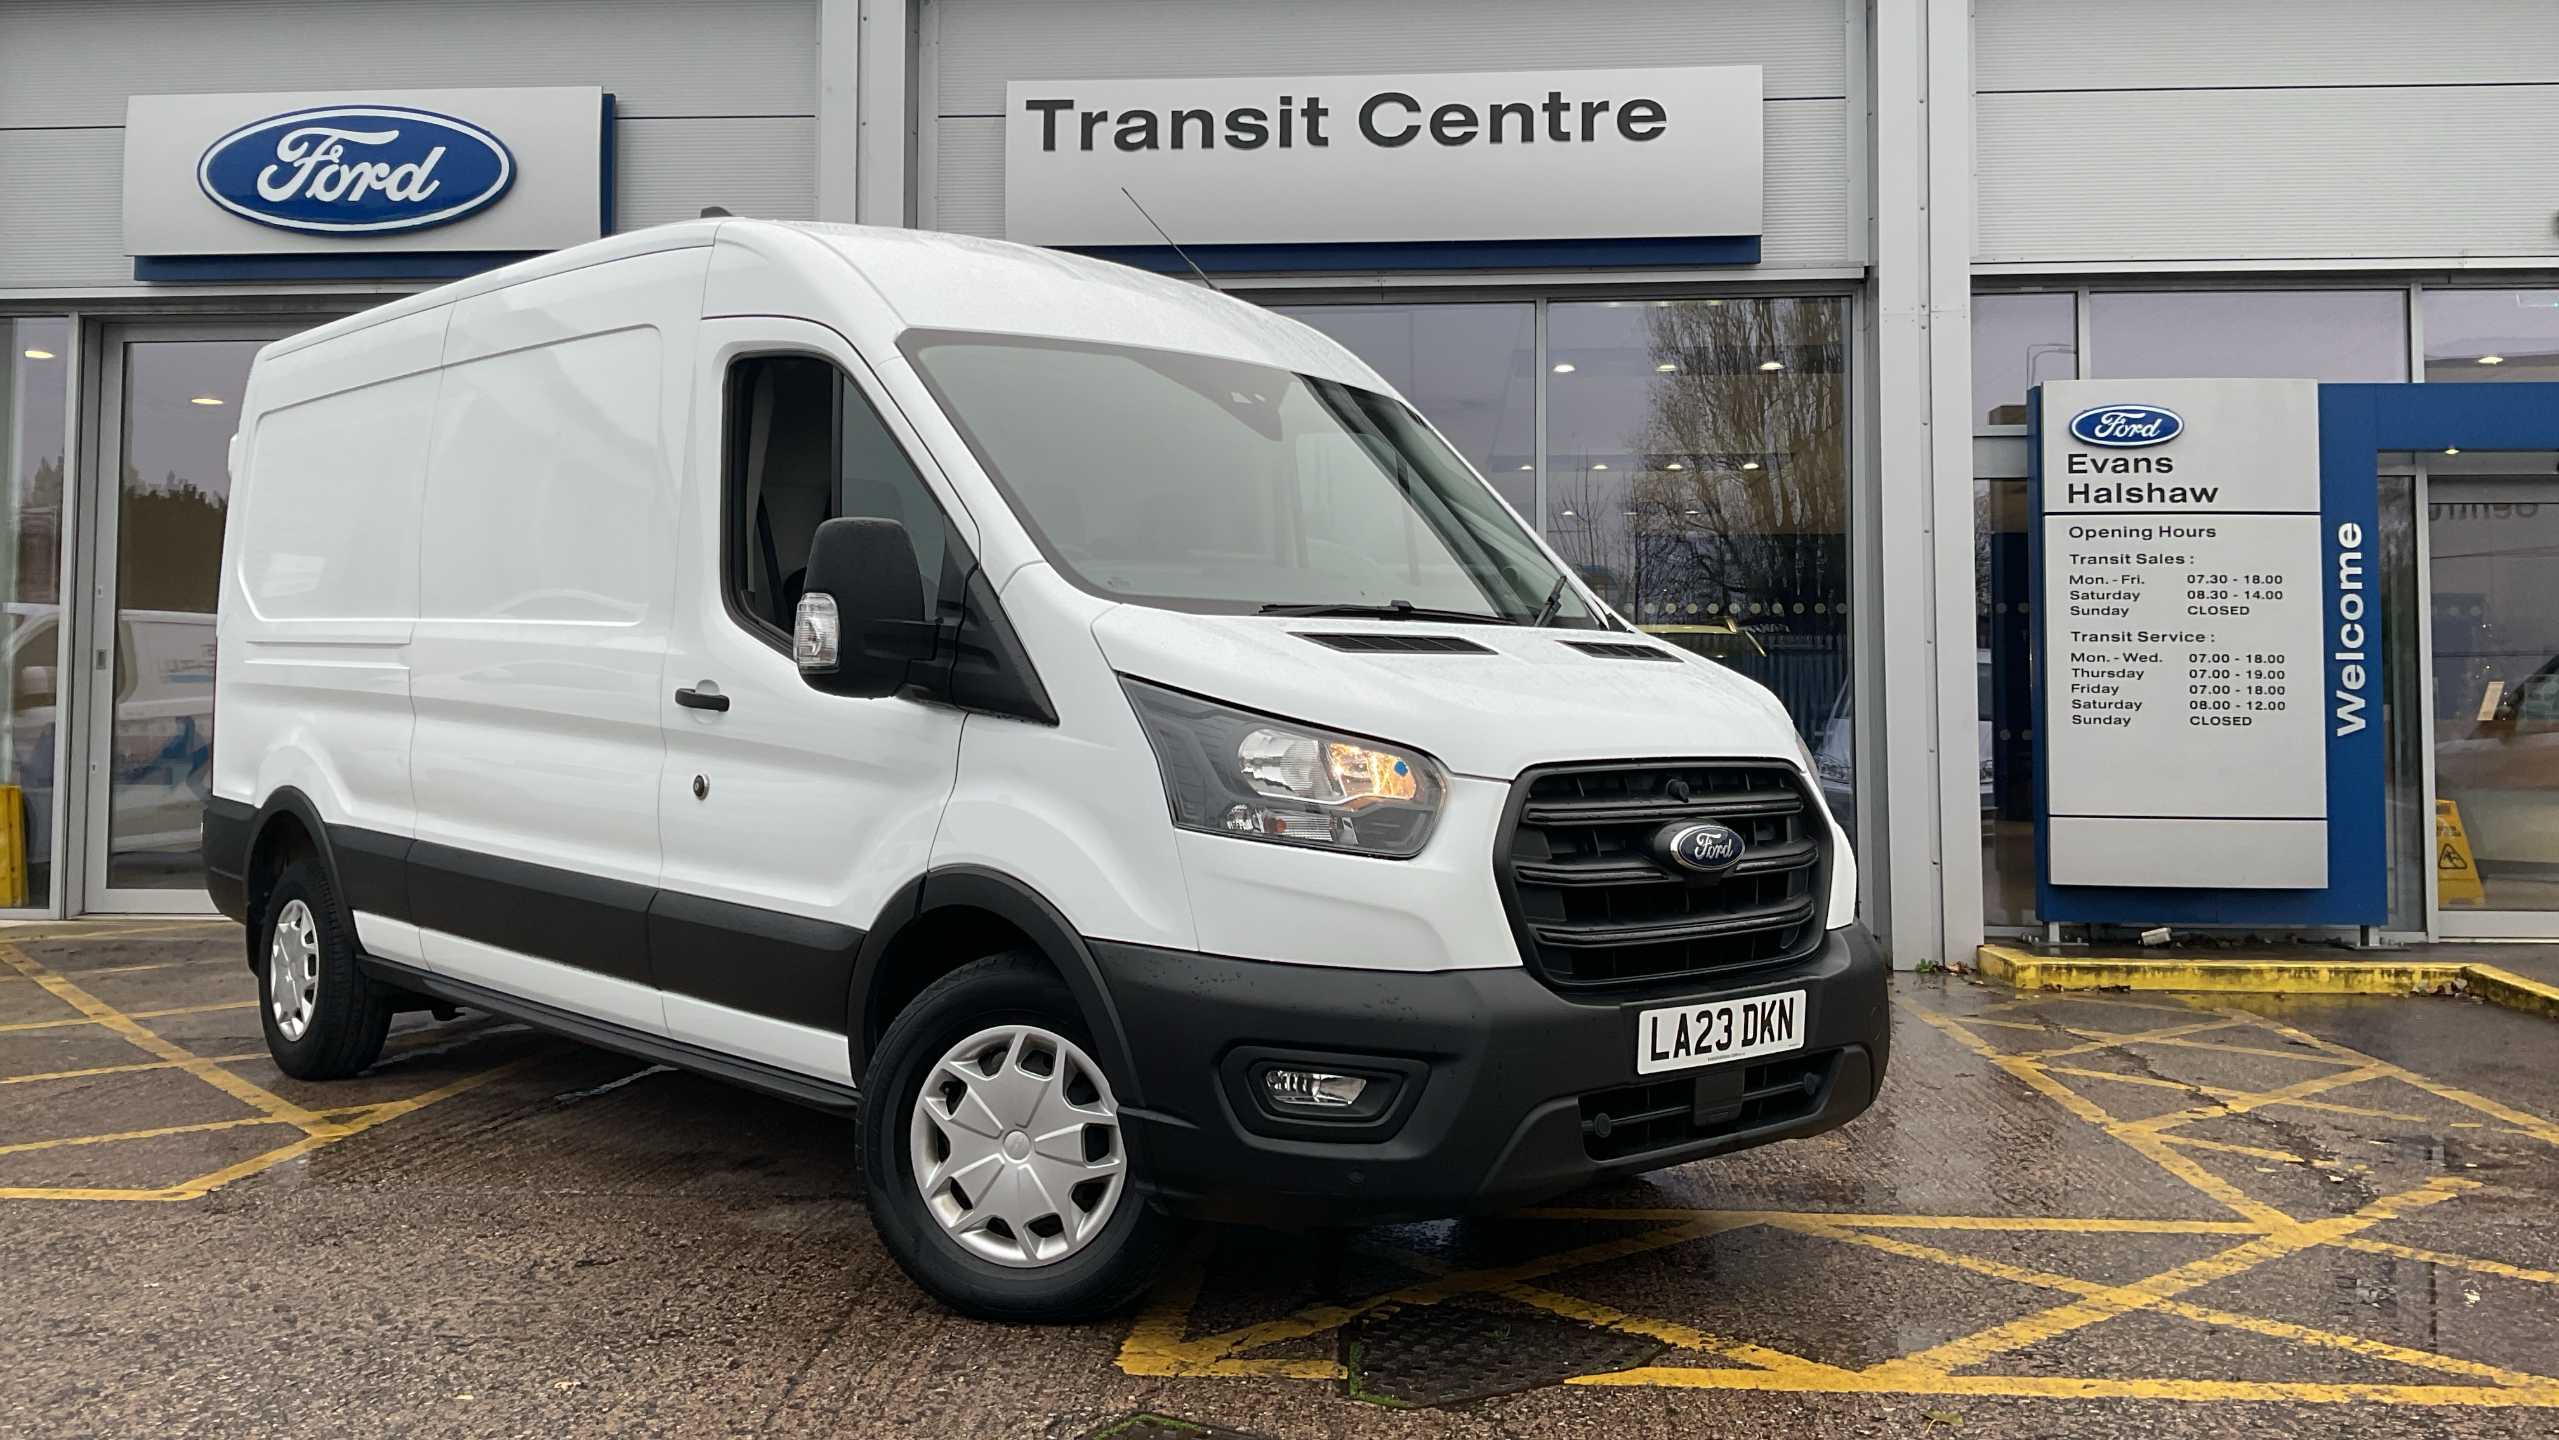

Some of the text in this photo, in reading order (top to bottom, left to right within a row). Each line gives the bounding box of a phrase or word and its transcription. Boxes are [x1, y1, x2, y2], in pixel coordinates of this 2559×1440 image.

[1026, 92, 1666, 152] Transit Centre
[257, 127, 446, 202] Ford
[2095, 411, 2161, 438] Ford
[2068, 453, 2173, 474] Evans
[2069, 483, 2218, 503] Halshaw
[2068, 525, 2217, 542] Opening Hours
[2068, 553, 2132, 565] Transit
[2135, 553, 2186, 565] Sales
[2069, 574, 2109, 585] Mon.
[2121, 574, 2145, 585] Fri.
[2186, 574, 2228, 585] 07.30
[2243, 574, 2283, 585] 18.00
[2069, 590, 2141, 603] Saturday
[2186, 590, 2229, 600] 08.30
[2244, 590, 2284, 601] 14.00
[2070, 605, 2250, 618] Sunday CLOSED
[2070, 631, 2133, 643] Transit
[2137, 630, 2206, 643] Service
[2336, 523, 2365, 736] Welcome
[2070, 652, 2111, 663] Mon.
[2122, 652, 2163, 663] Wed.
[2188, 653, 2230, 664] 07.00
[2245, 653, 2285, 665] 18.00
[2071, 667, 2145, 681] Thursday
[2188, 668, 2231, 680] 07.00
[2245, 669, 2286, 680] 19.00
[2071, 683, 2120, 697] Friday
[2189, 684, 2231, 695] 07.00
[2246, 685, 2286, 696] 18.00
[2071, 698, 2143, 712] Saturday
[2189, 700, 2231, 711] 08.00
[2246, 700, 2286, 711] 12.00
[2071, 714, 2253, 728] Sunday CLOSED
[1694, 832, 1734, 860] Ford
[1651, 997, 1794, 1062] LA23 DKN
